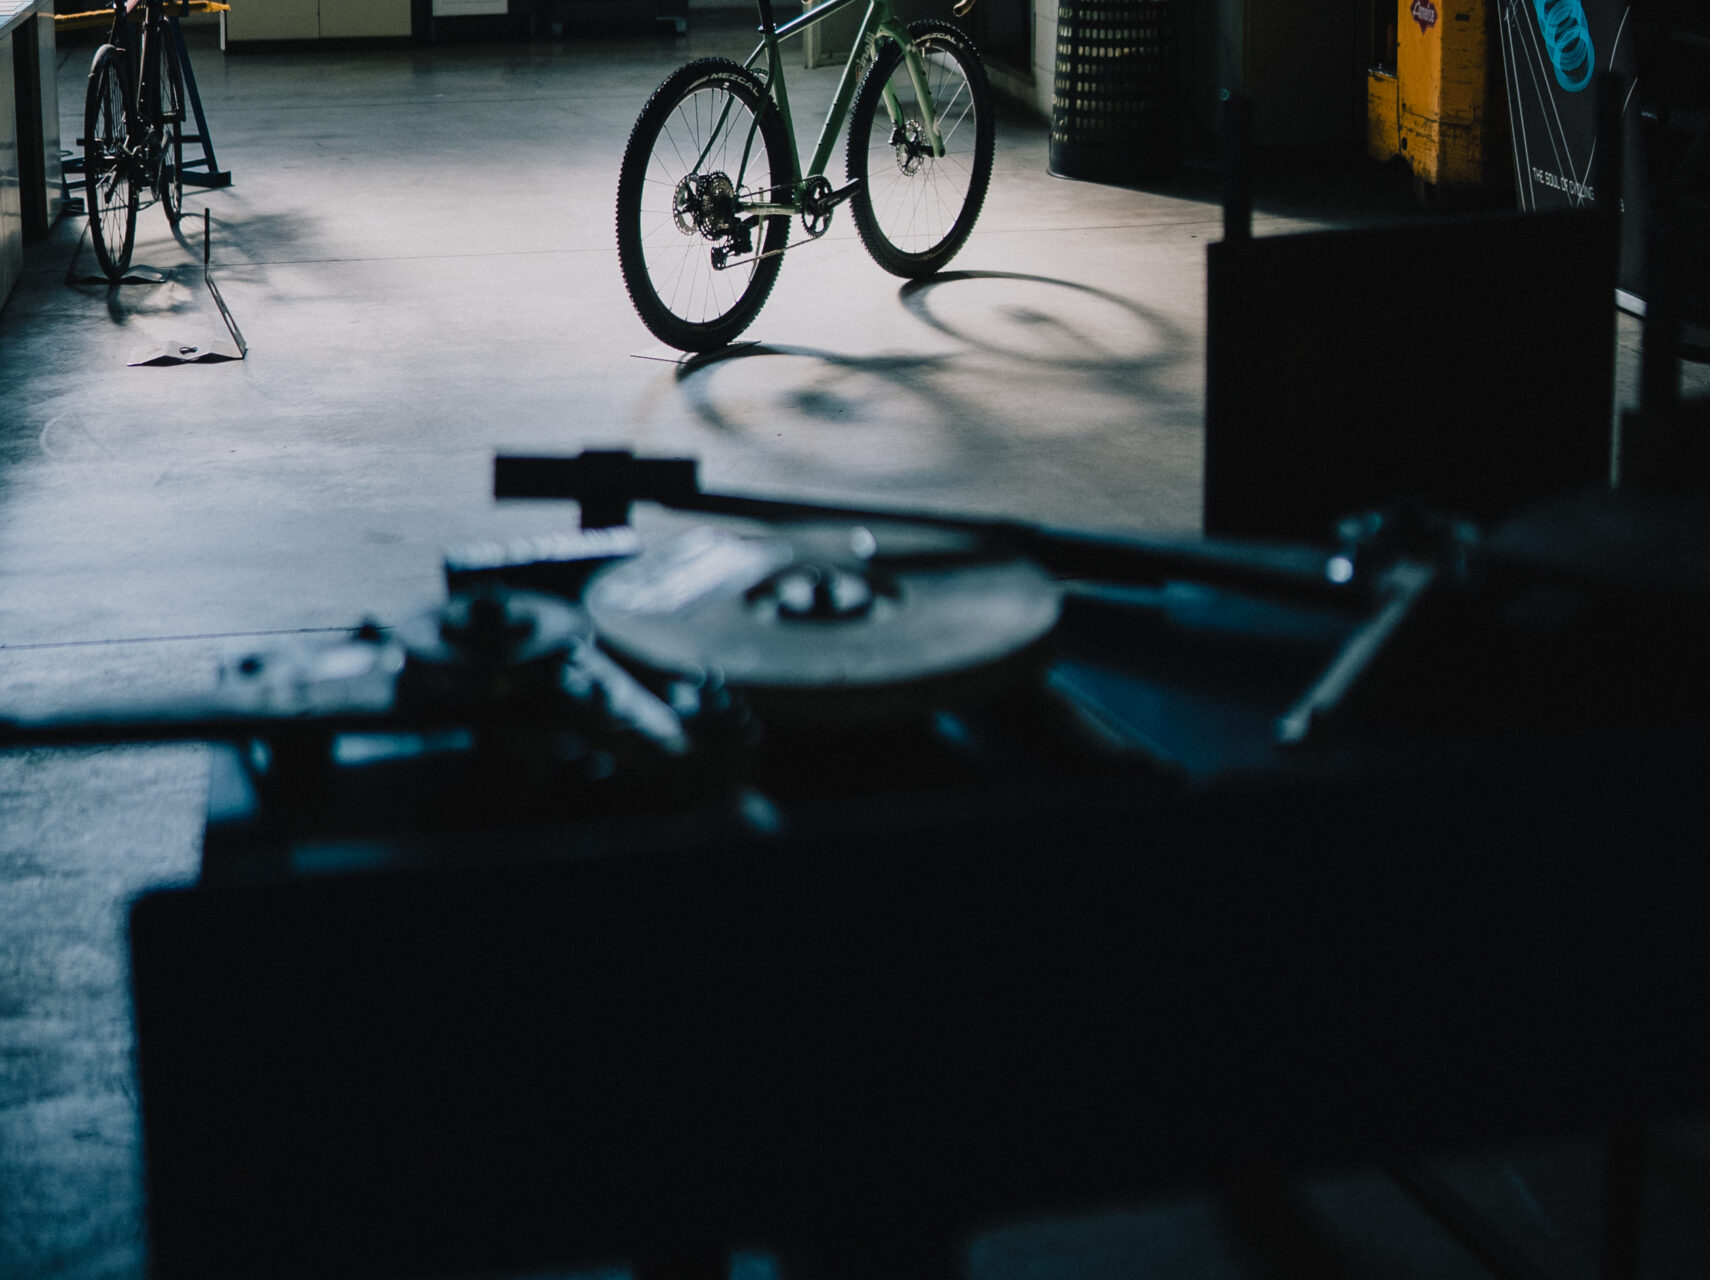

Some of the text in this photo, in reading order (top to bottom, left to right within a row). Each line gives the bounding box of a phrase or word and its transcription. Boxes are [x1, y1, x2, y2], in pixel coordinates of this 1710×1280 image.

[710, 72, 760, 97] MEZCAL
[1532, 166, 1545, 185] THE
[1544, 171, 1561, 190] SOUL
